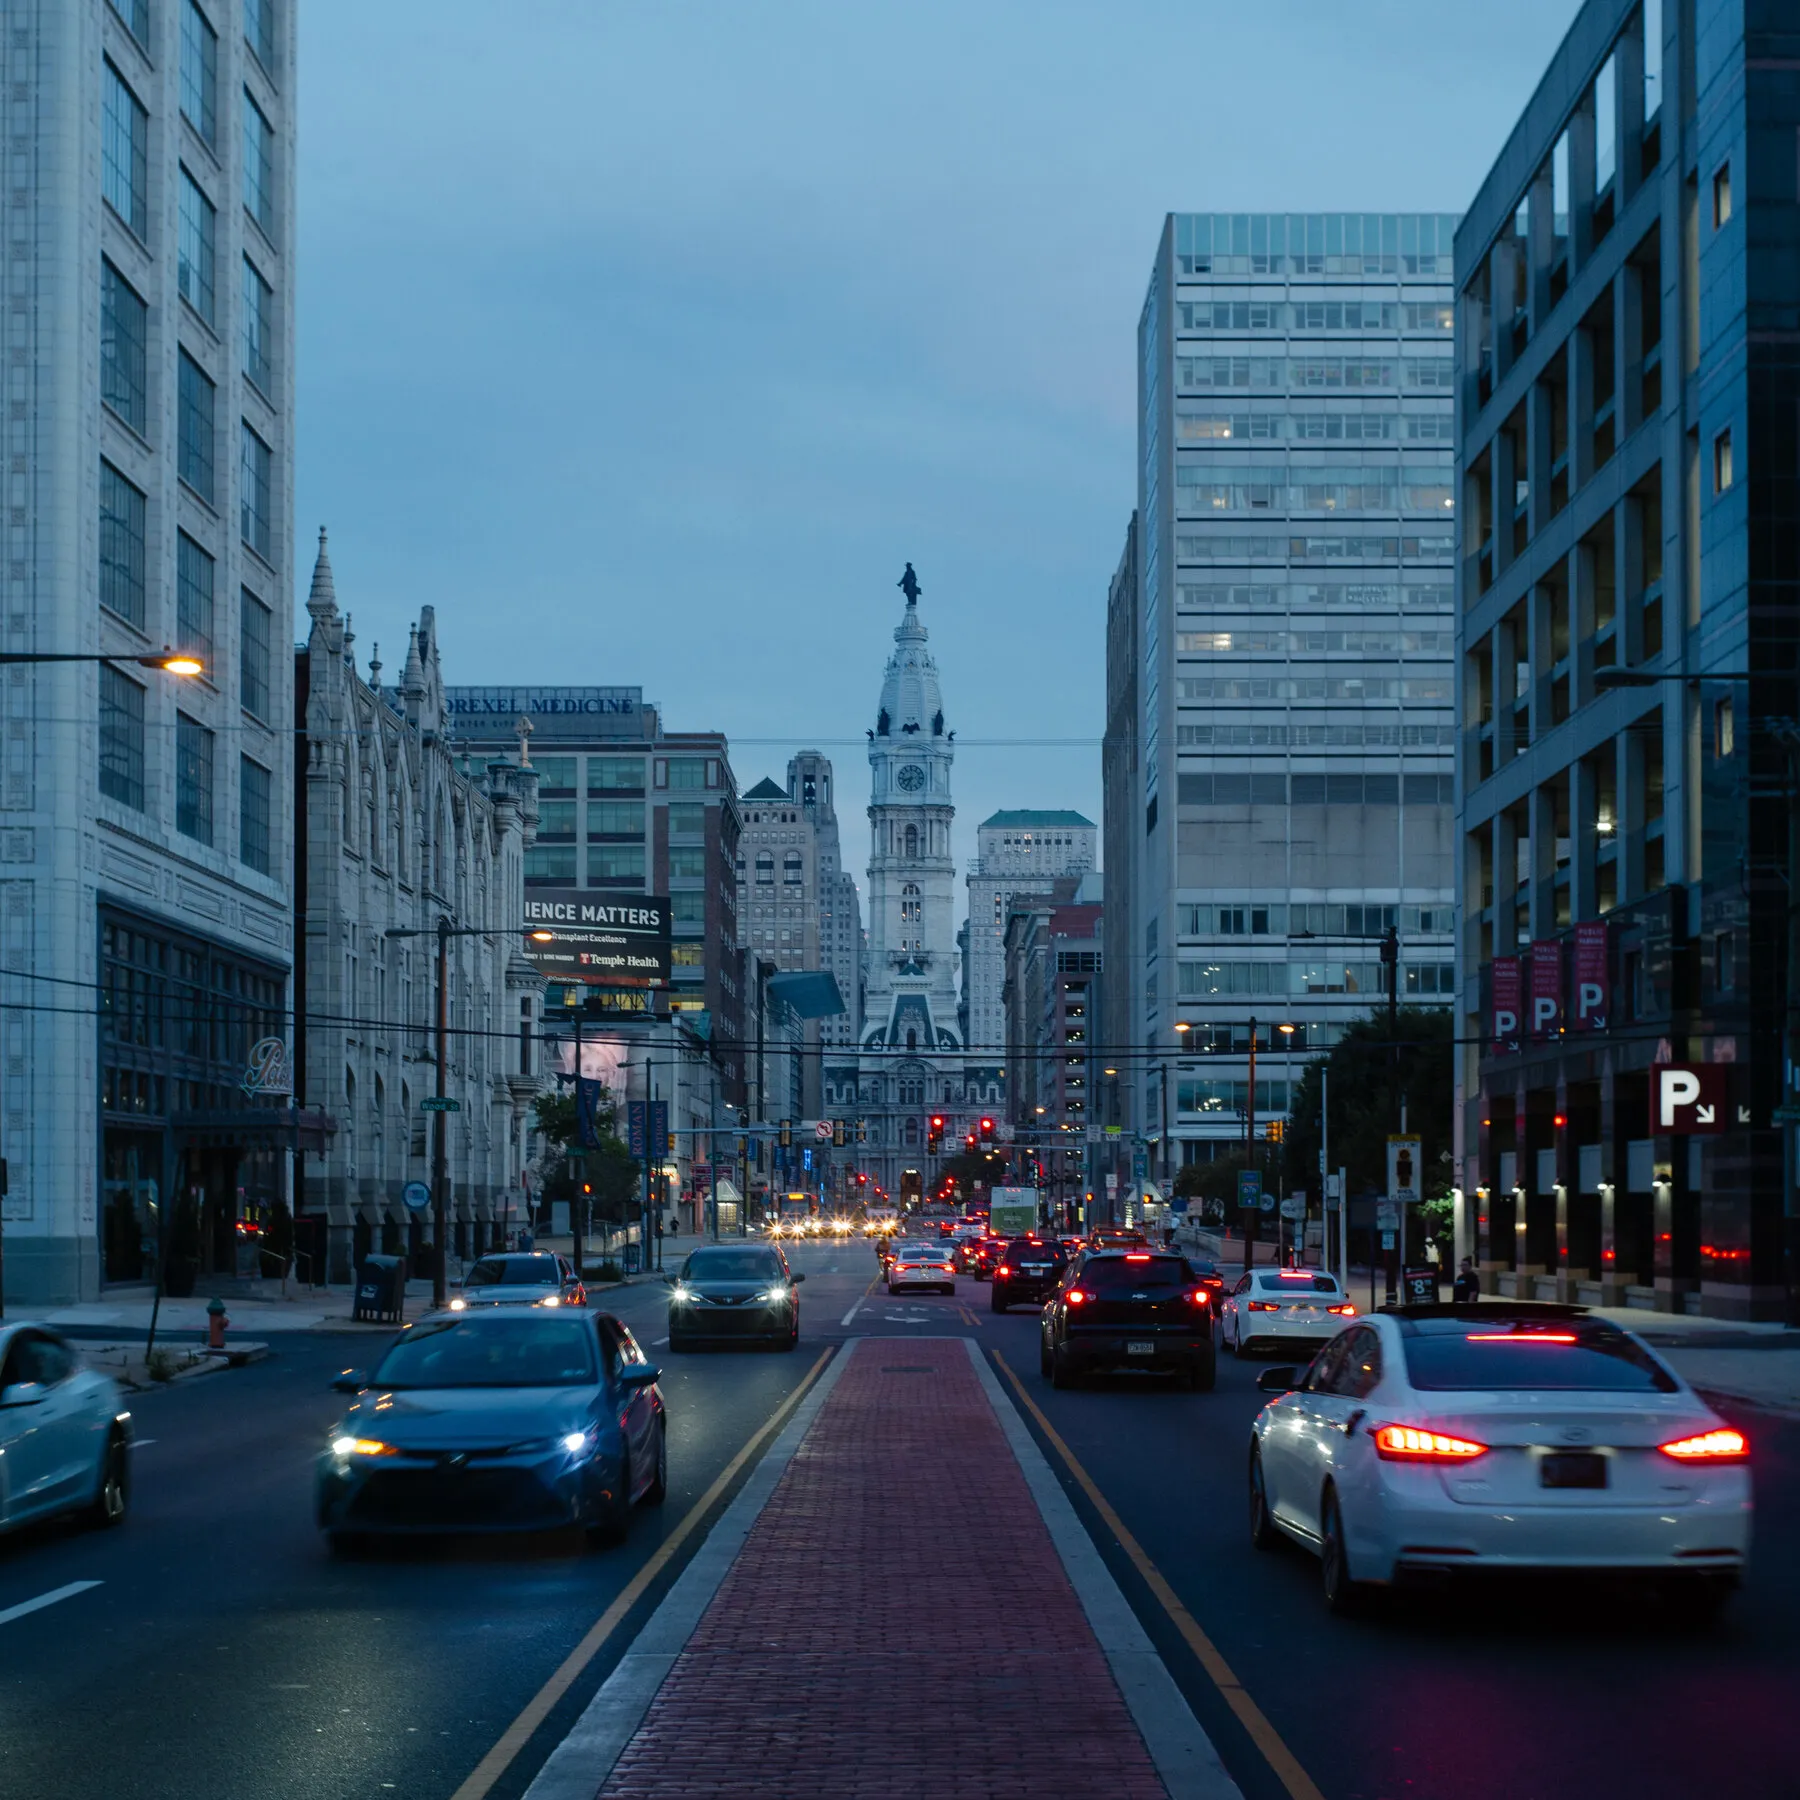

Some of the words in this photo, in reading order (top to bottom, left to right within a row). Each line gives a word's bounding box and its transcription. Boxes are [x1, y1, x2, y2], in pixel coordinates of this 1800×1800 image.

[531, 699, 634, 714] MEDICINE
[581, 904, 660, 926] MATTERS
[589, 934, 627, 943] Excellence
[590, 953, 626, 968] Temple
[627, 956, 660, 968] Health
[1534, 997, 1558, 1031] P
[1579, 983, 1604, 1019] P
[1495, 1011, 1517, 1042] P
[1660, 1069, 1701, 1127] P
[632, 1105, 643, 1155] ROMAN
